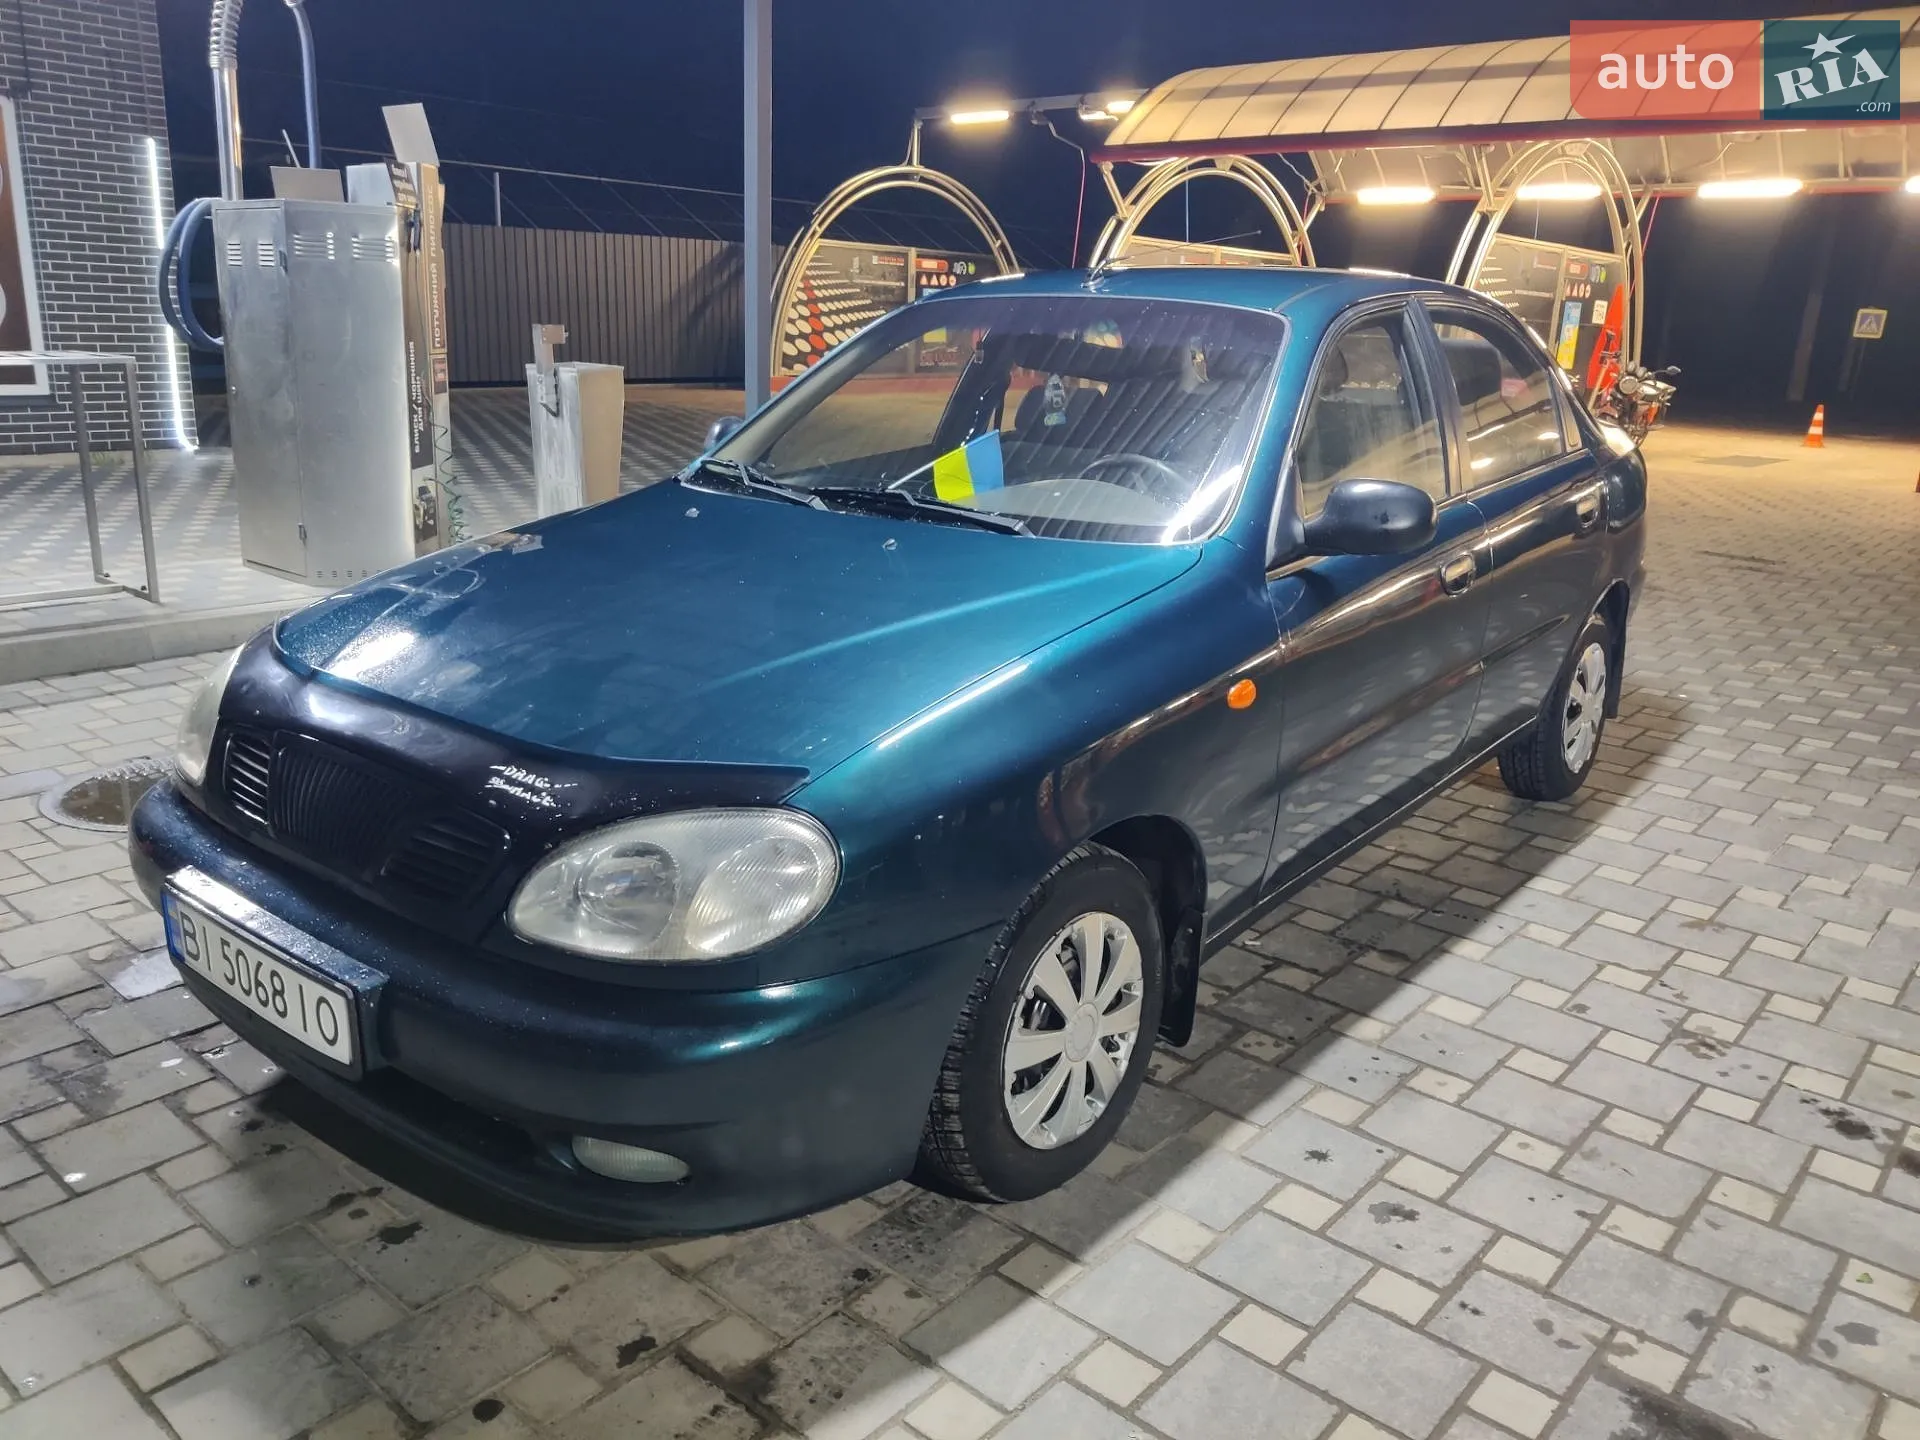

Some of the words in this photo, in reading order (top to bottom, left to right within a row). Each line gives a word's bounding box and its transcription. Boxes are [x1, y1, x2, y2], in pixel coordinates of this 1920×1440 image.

[427, 185, 436, 257] ПИЛОСОС
[430, 262, 441, 348] ПОТУЖНИЙ
[180, 911, 212, 972] BI
[220, 936, 288, 1019] 5068
[298, 983, 339, 1047] IO
